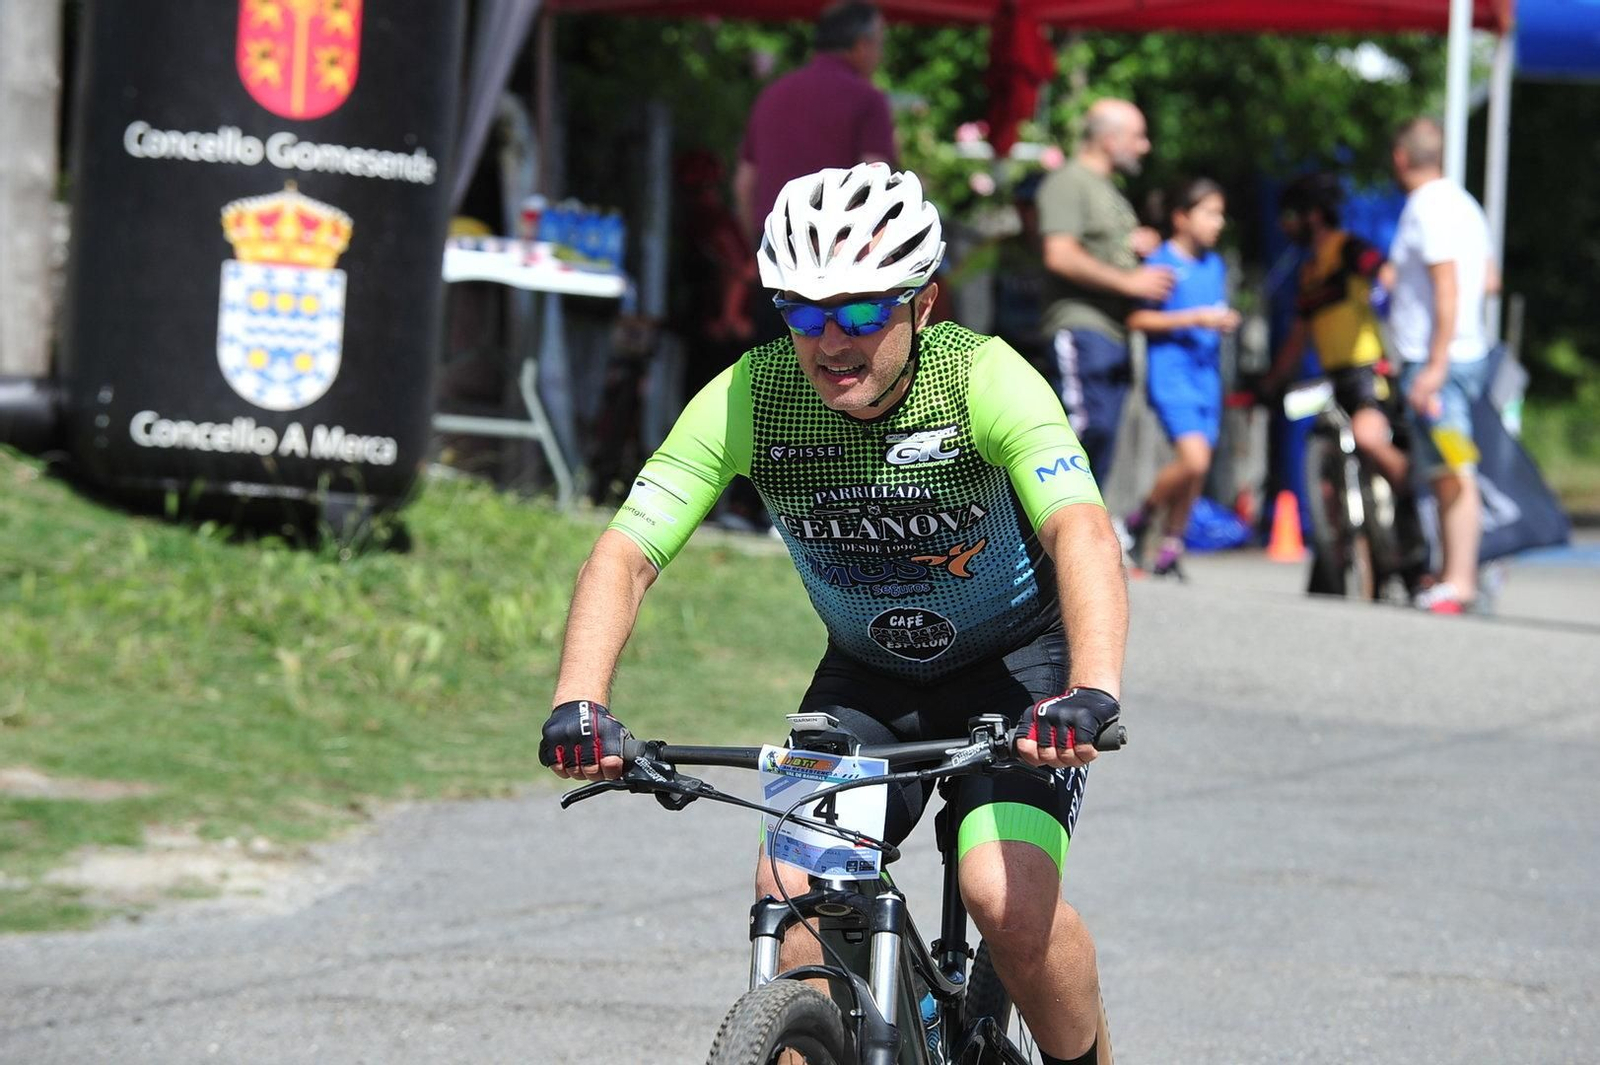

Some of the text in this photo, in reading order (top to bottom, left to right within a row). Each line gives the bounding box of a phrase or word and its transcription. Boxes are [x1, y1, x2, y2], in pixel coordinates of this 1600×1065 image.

[123, 120, 264, 166] Concello
[129, 410, 398, 466] Concello A Merca
[788, 446, 842, 458] PISSEI
[815, 485, 932, 504] PARRILLADA
[780, 504, 988, 541] CELANOVA
[841, 543, 882, 553] DESDE
[889, 612, 924, 628] CAFÉ
[812, 791, 839, 827] 4
